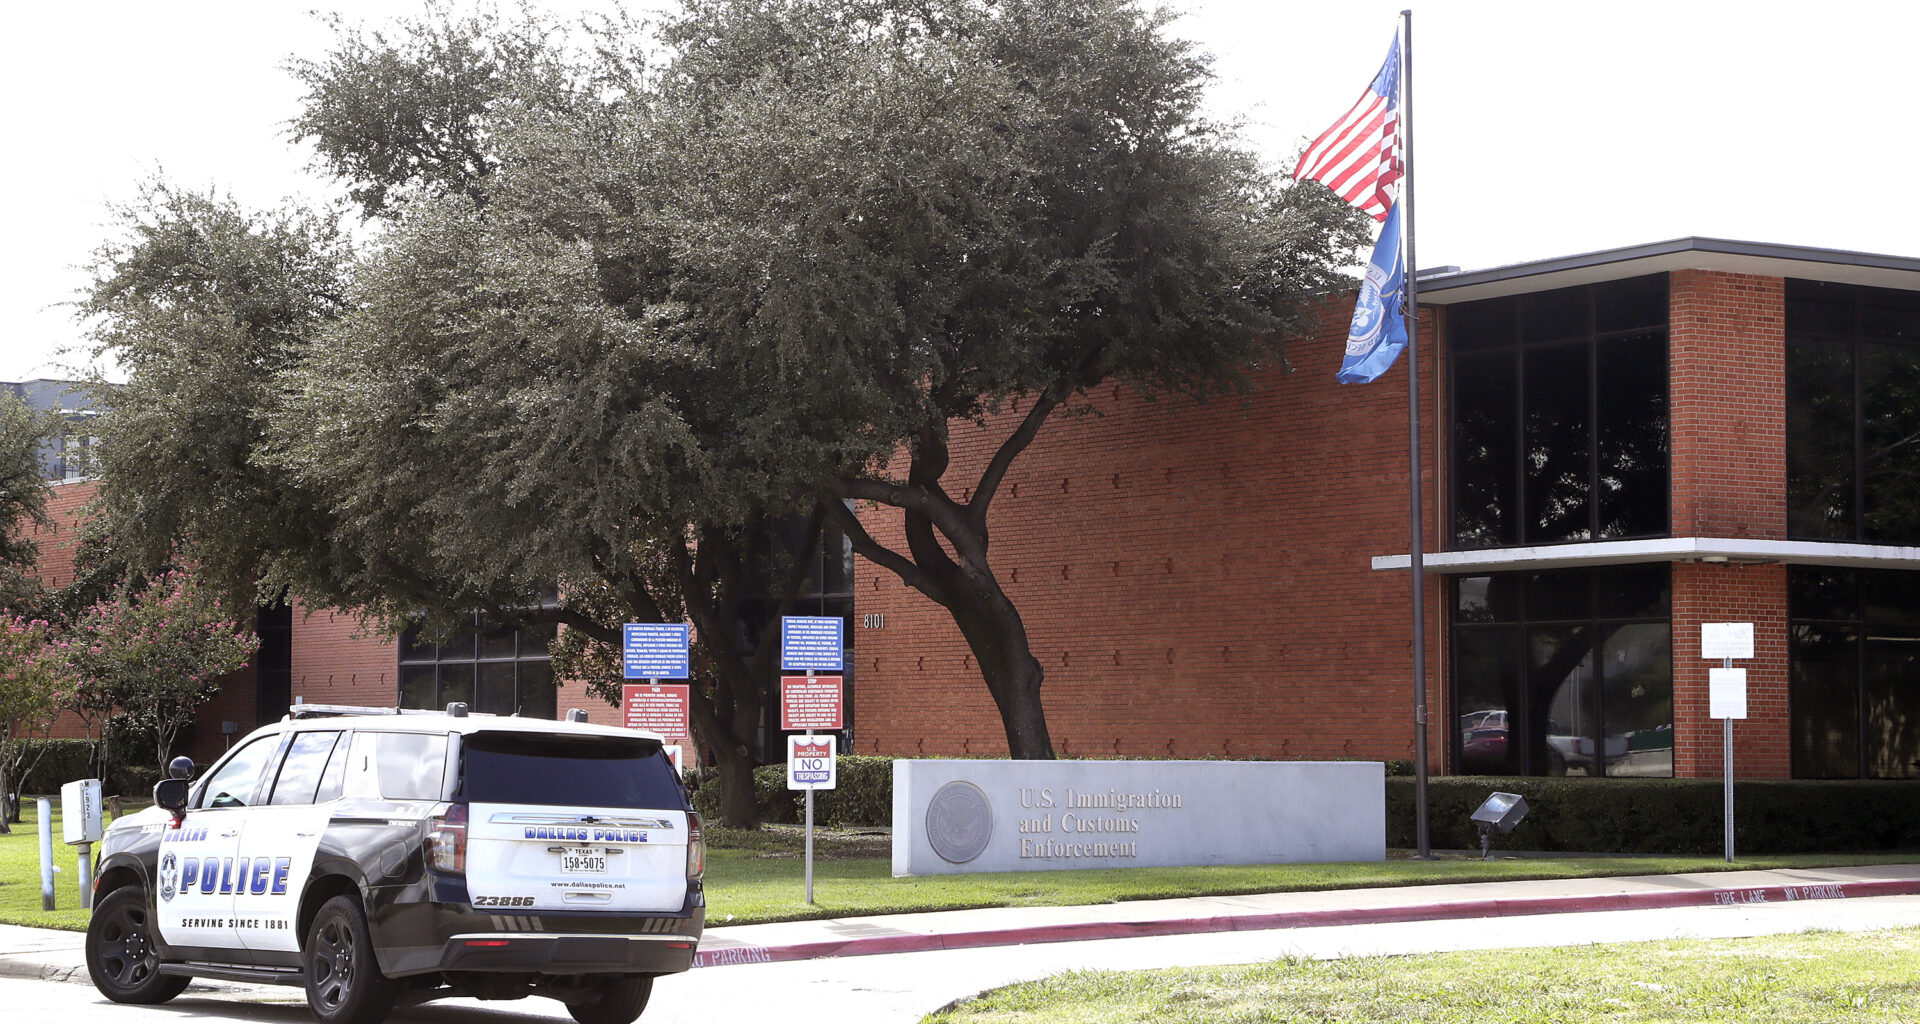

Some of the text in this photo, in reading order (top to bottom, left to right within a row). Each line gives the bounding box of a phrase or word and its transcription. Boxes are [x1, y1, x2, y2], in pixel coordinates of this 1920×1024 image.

[864, 613, 884, 629] 8101
[802, 758, 823, 770] NO
[796, 772, 828, 781] TRESPASSING
[1019, 788, 1182, 812] U.S. Immigration
[1019, 812, 1139, 833] and Customs
[164, 828, 209, 843] DALLAS
[524, 827, 648, 843] DALLAS POLICE
[1019, 837, 1137, 859] Enforcement
[180, 856, 292, 896] POLICE
[550, 881, 626, 889] www.dallaspolice.net
[474, 895, 536, 907] 23886
[1714, 891, 1738, 905] FIRE
[1740, 889, 1769, 904] LANE
[1802, 884, 1846, 900] PARKING
[182, 918, 288, 930] SERVING SINCE 1881
[711, 946, 772, 966] PARKING
